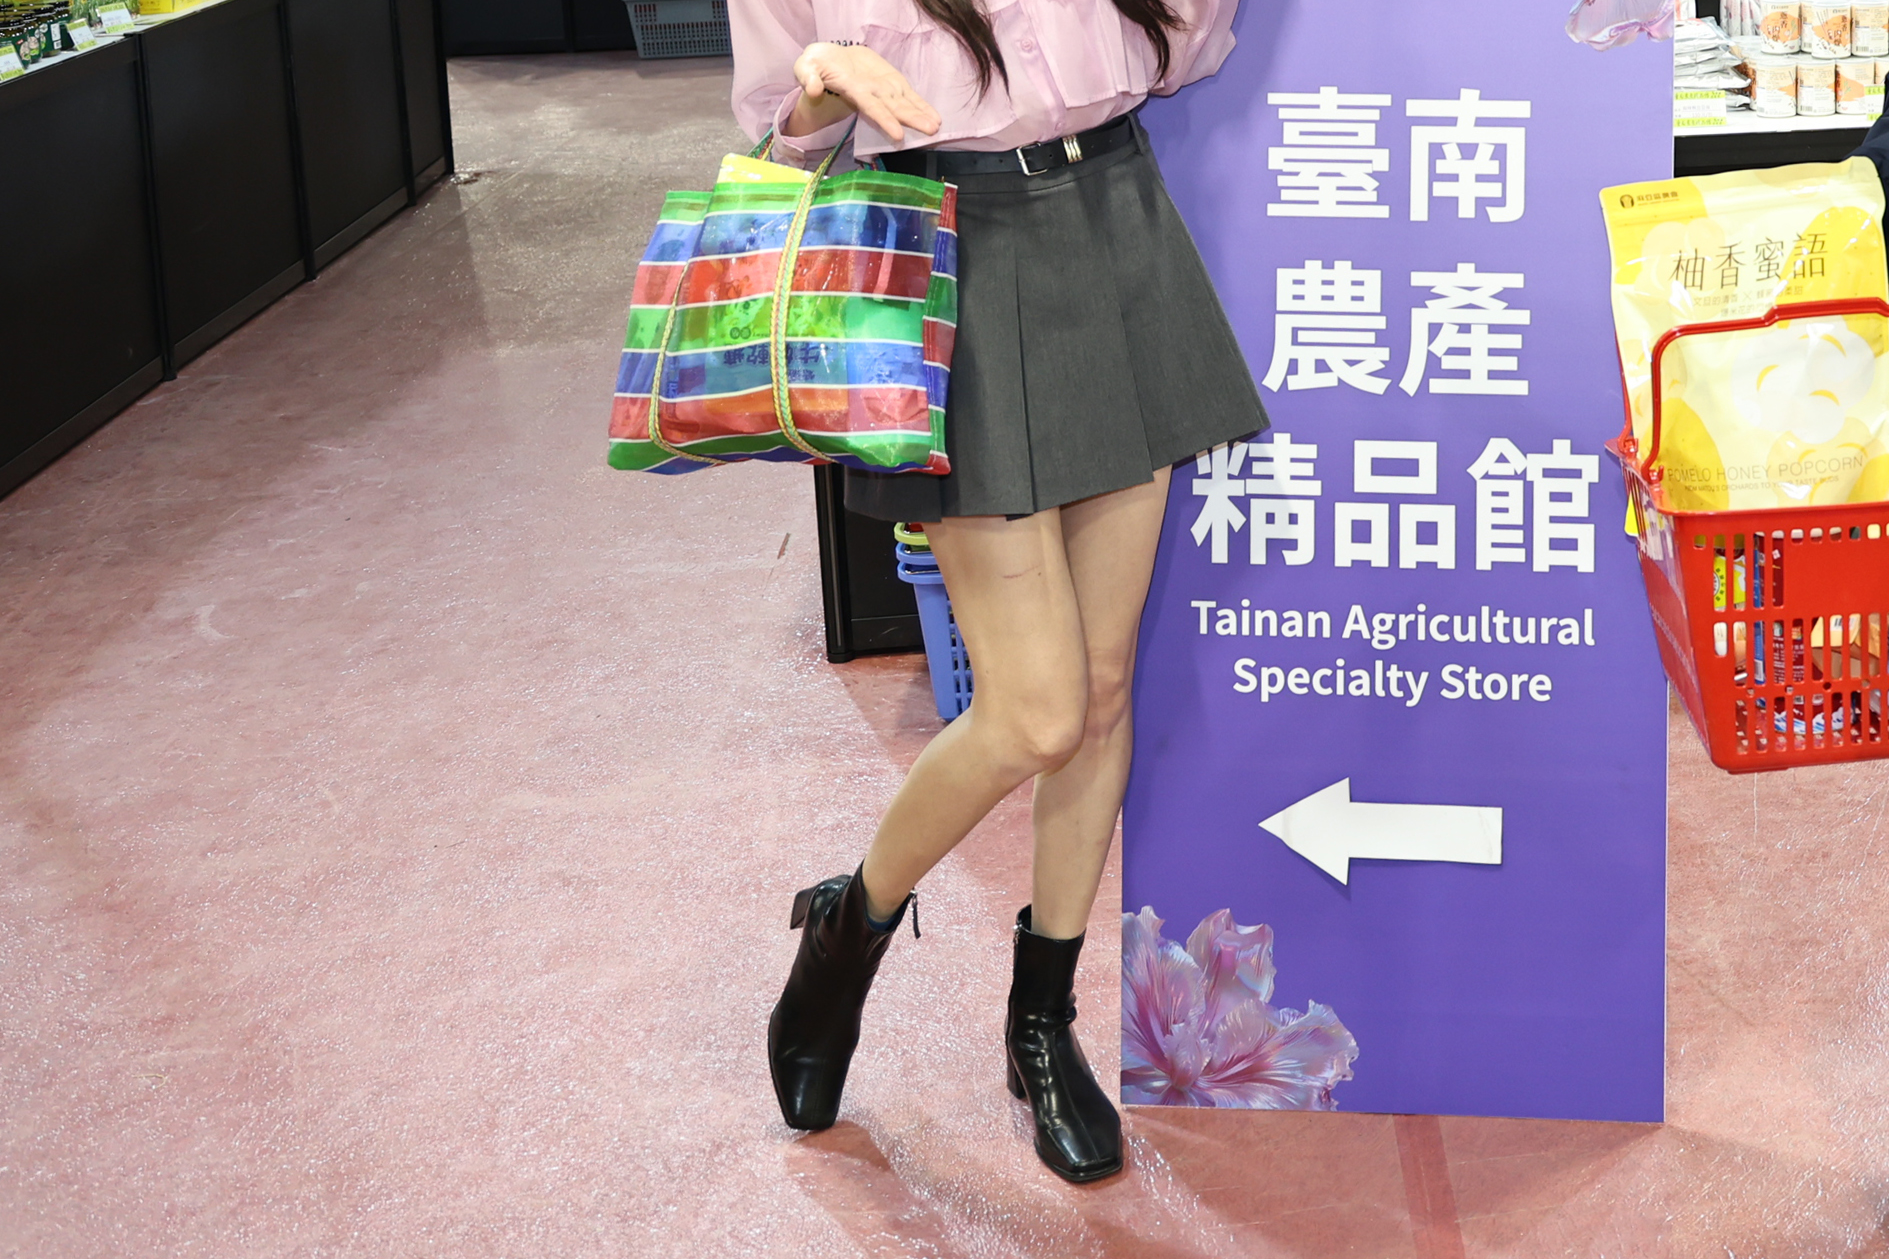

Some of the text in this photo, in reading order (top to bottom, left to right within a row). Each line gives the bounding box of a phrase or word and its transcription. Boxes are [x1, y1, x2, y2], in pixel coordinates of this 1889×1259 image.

[1266, 85, 1531, 223] 臺南
[1668, 232, 1828, 291] 柚香蜜語
[1262, 260, 1531, 397] 農產
[1668, 455, 1864, 483] POMELO HONEY POPCORN
[1190, 433, 1600, 573] 精品館
[1190, 598, 1596, 651] Tainan Agricultural
[1232, 656, 1553, 708] Specialty Store
